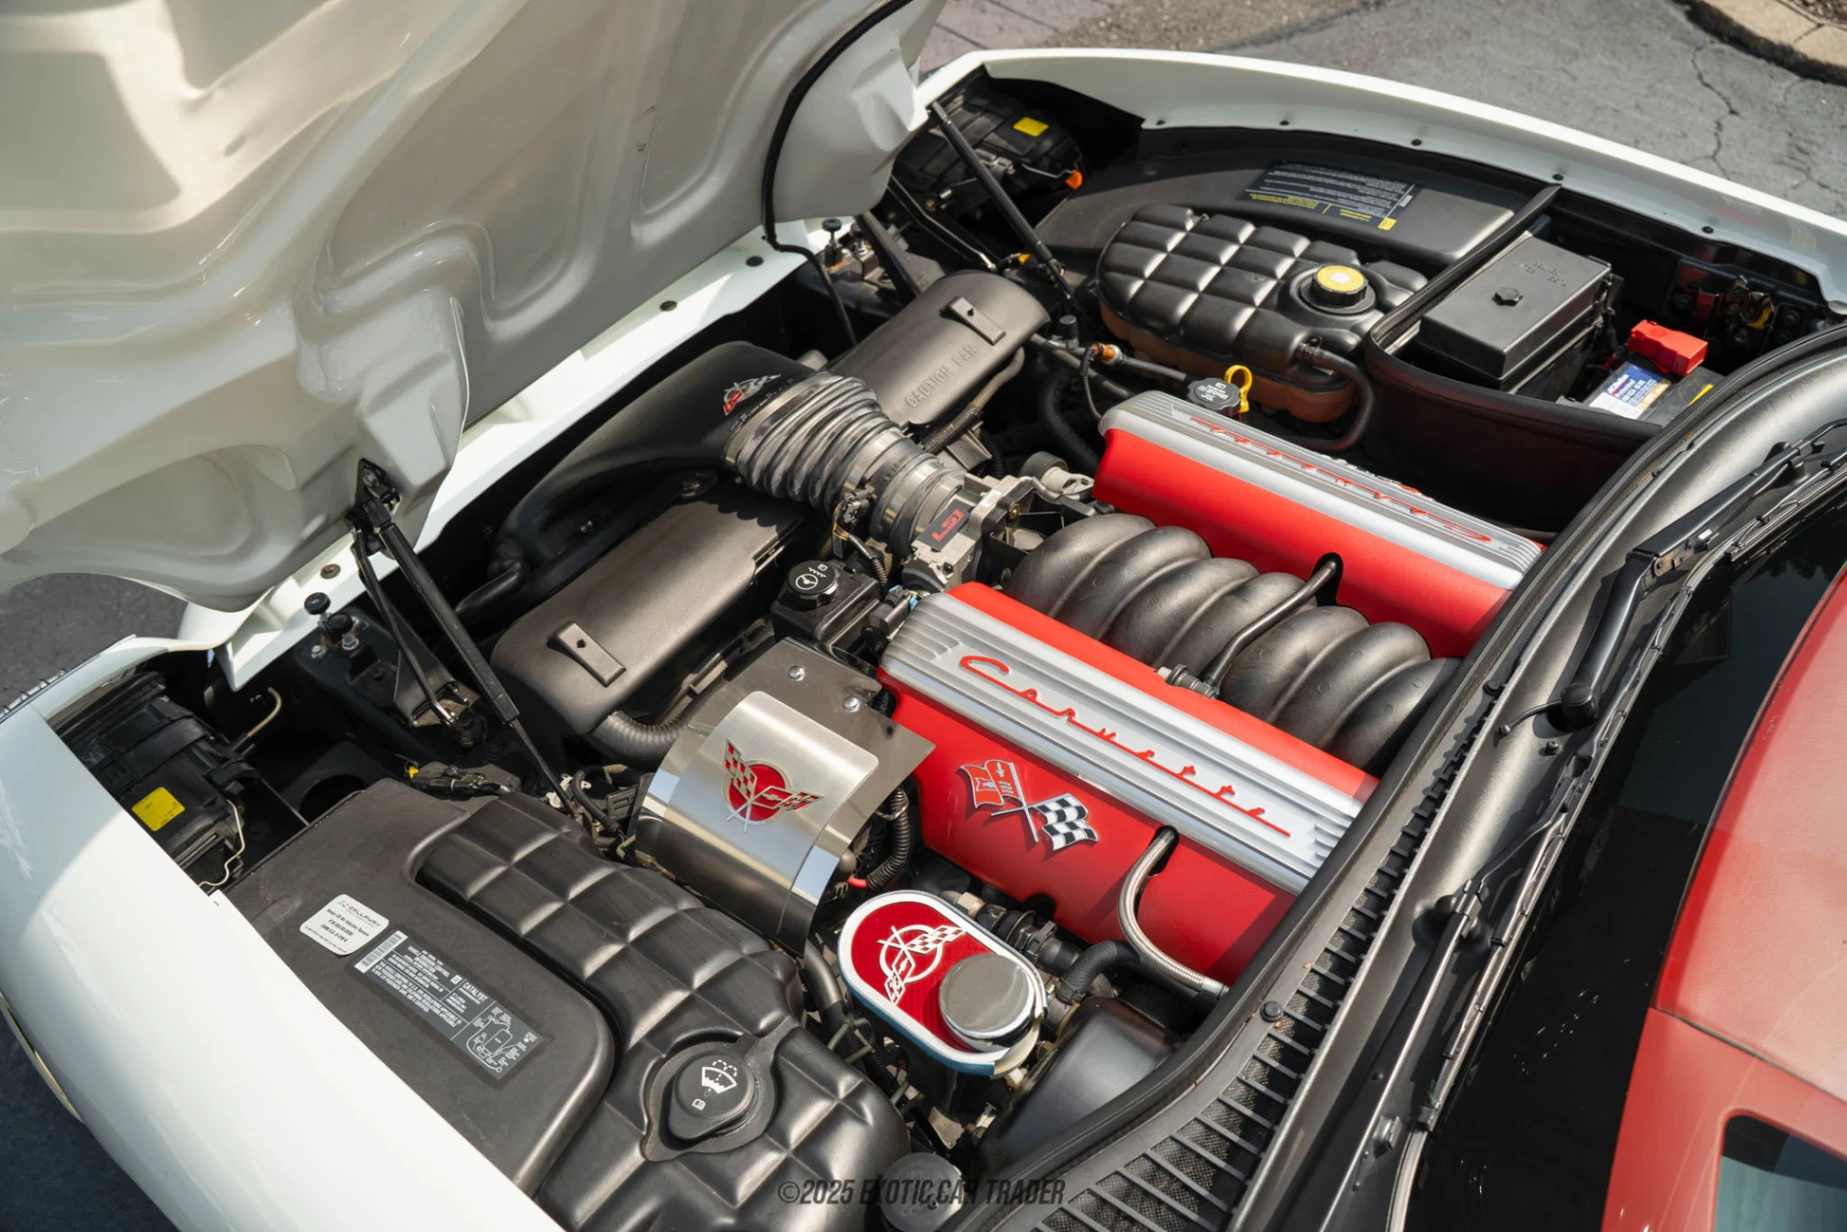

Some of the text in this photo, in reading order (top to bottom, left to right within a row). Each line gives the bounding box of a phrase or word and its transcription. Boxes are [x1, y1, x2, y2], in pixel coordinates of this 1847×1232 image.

[904, 344, 977, 408] CAUTION FAN
[932, 508, 964, 542] LS1
[959, 655, 1291, 837] Corvette
[348, 905, 381, 927] CALLAWAY
[461, 981, 488, 1002] CATALYST
